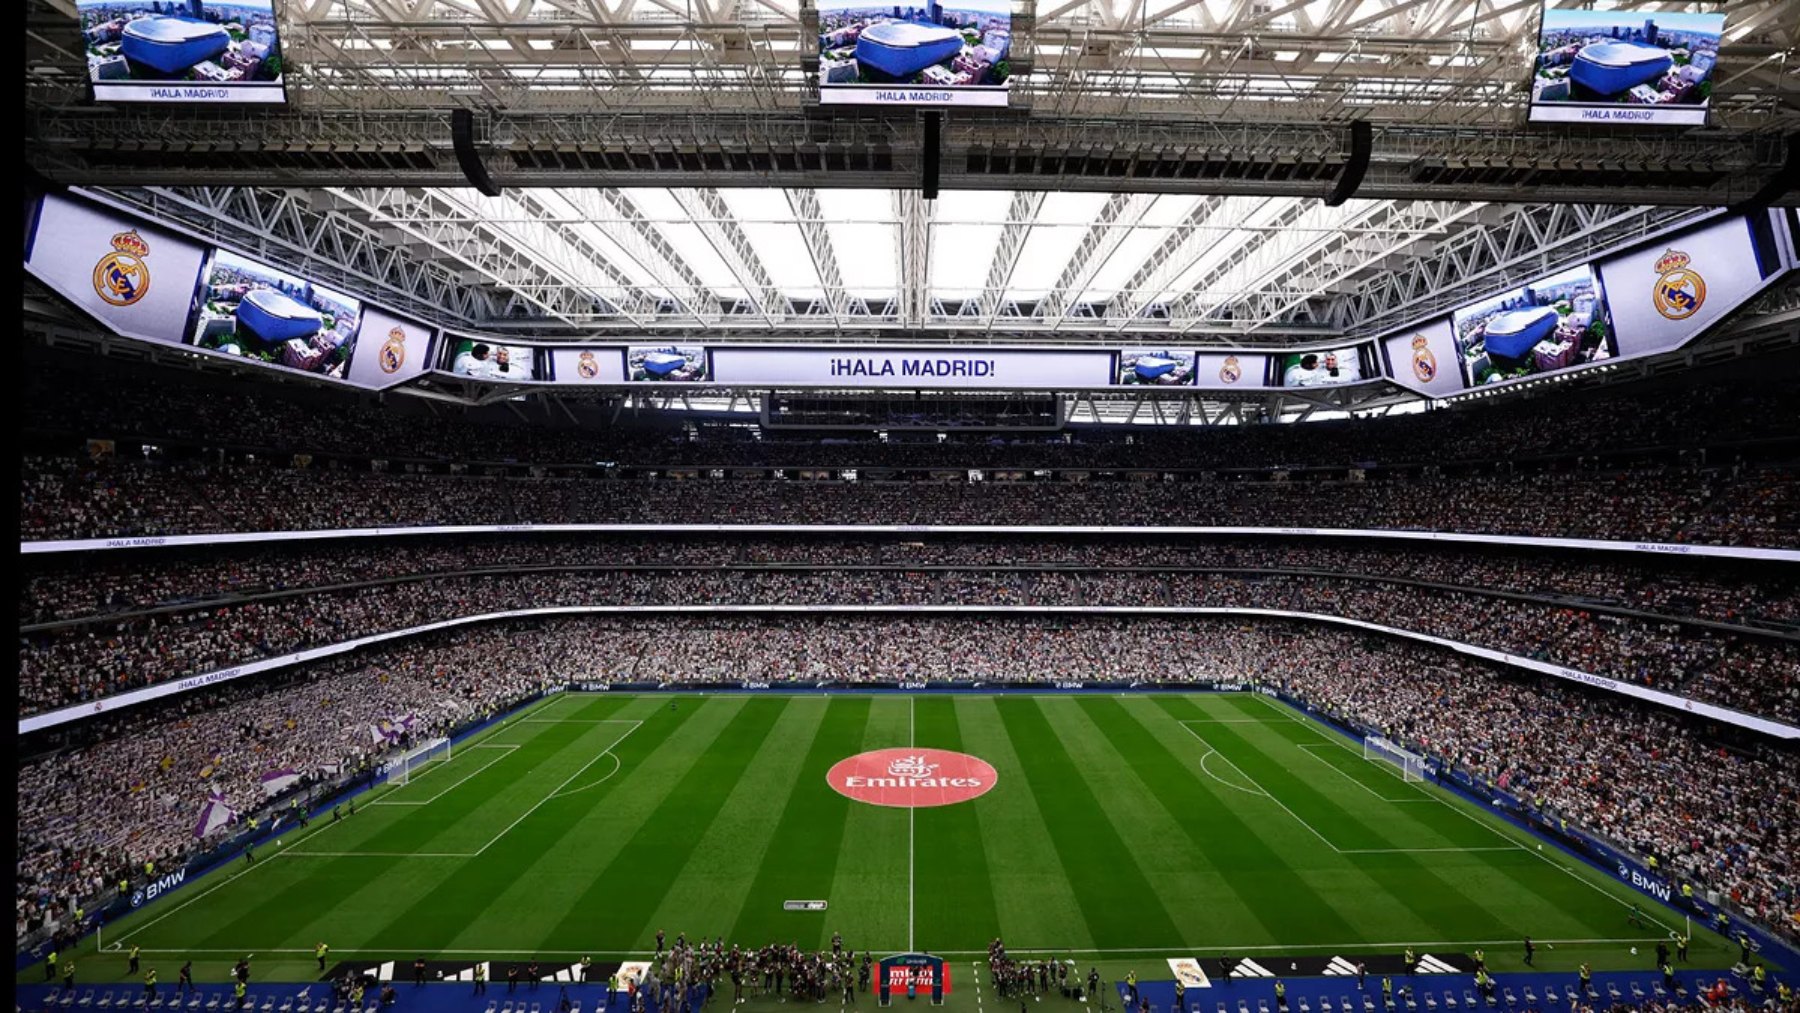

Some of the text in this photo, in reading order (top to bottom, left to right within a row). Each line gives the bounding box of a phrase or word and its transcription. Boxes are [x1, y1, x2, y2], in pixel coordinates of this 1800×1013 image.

[151, 88, 229, 99] ¡HALA MADRID!
[876, 91, 953, 102] ¡HALA MADRID!
[1582, 109, 1655, 121] ¡HALA MADRID!
[831, 358, 995, 377] ¡HALA MADRID!
[906, 682, 926, 690] BMW
[845, 776, 982, 788] Emirates
[146, 868, 186, 900] BMW
[1632, 871, 1671, 902] BMW
